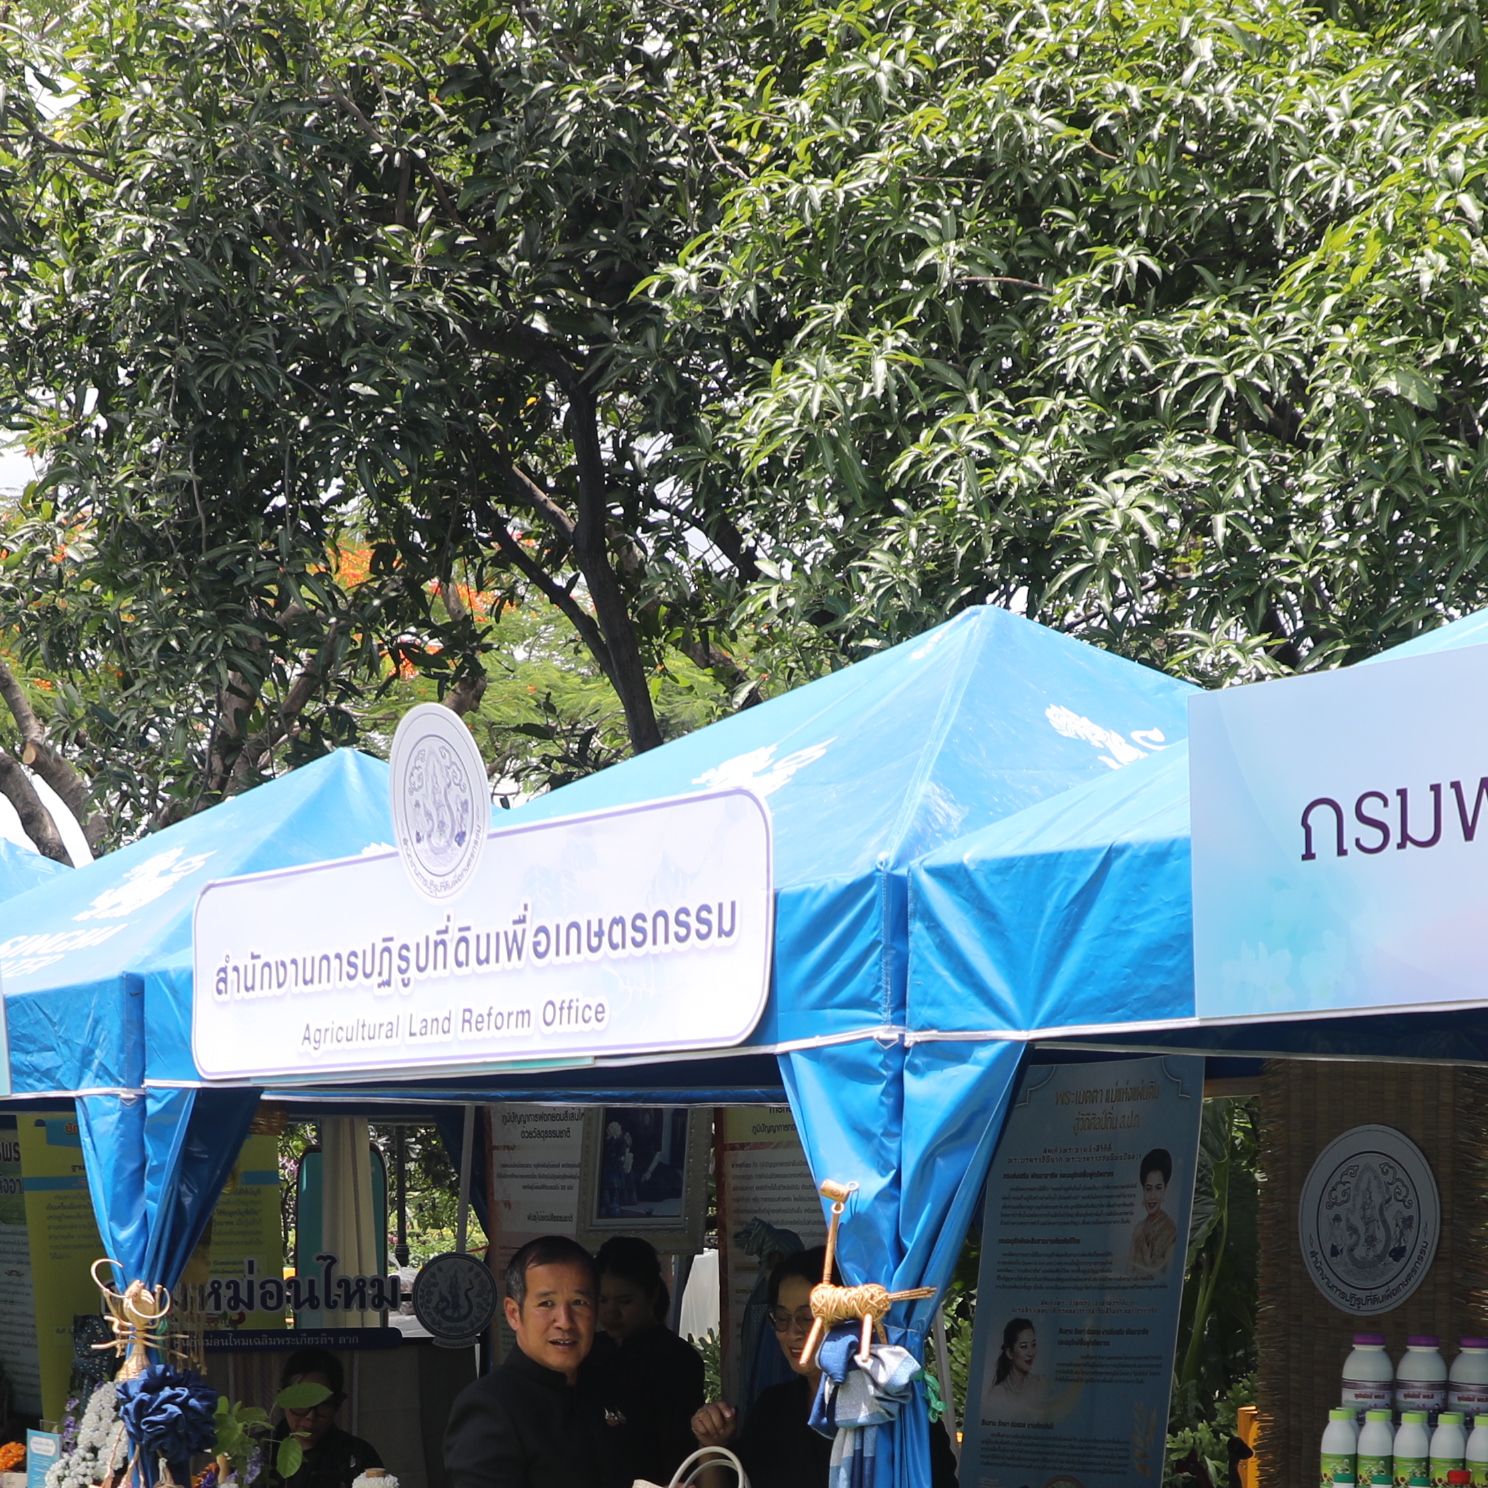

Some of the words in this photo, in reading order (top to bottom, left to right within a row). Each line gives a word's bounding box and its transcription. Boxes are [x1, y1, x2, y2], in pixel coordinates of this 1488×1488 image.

[214, 900, 737, 998] สำนักงานการปฏิรูปที่ดินเพื่อเกษตรกรรม
[301, 1014, 400, 1051] Agricultural
[408, 1008, 452, 1037] Land
[461, 1006, 532, 1034] Reform
[542, 1000, 606, 1027] Office
